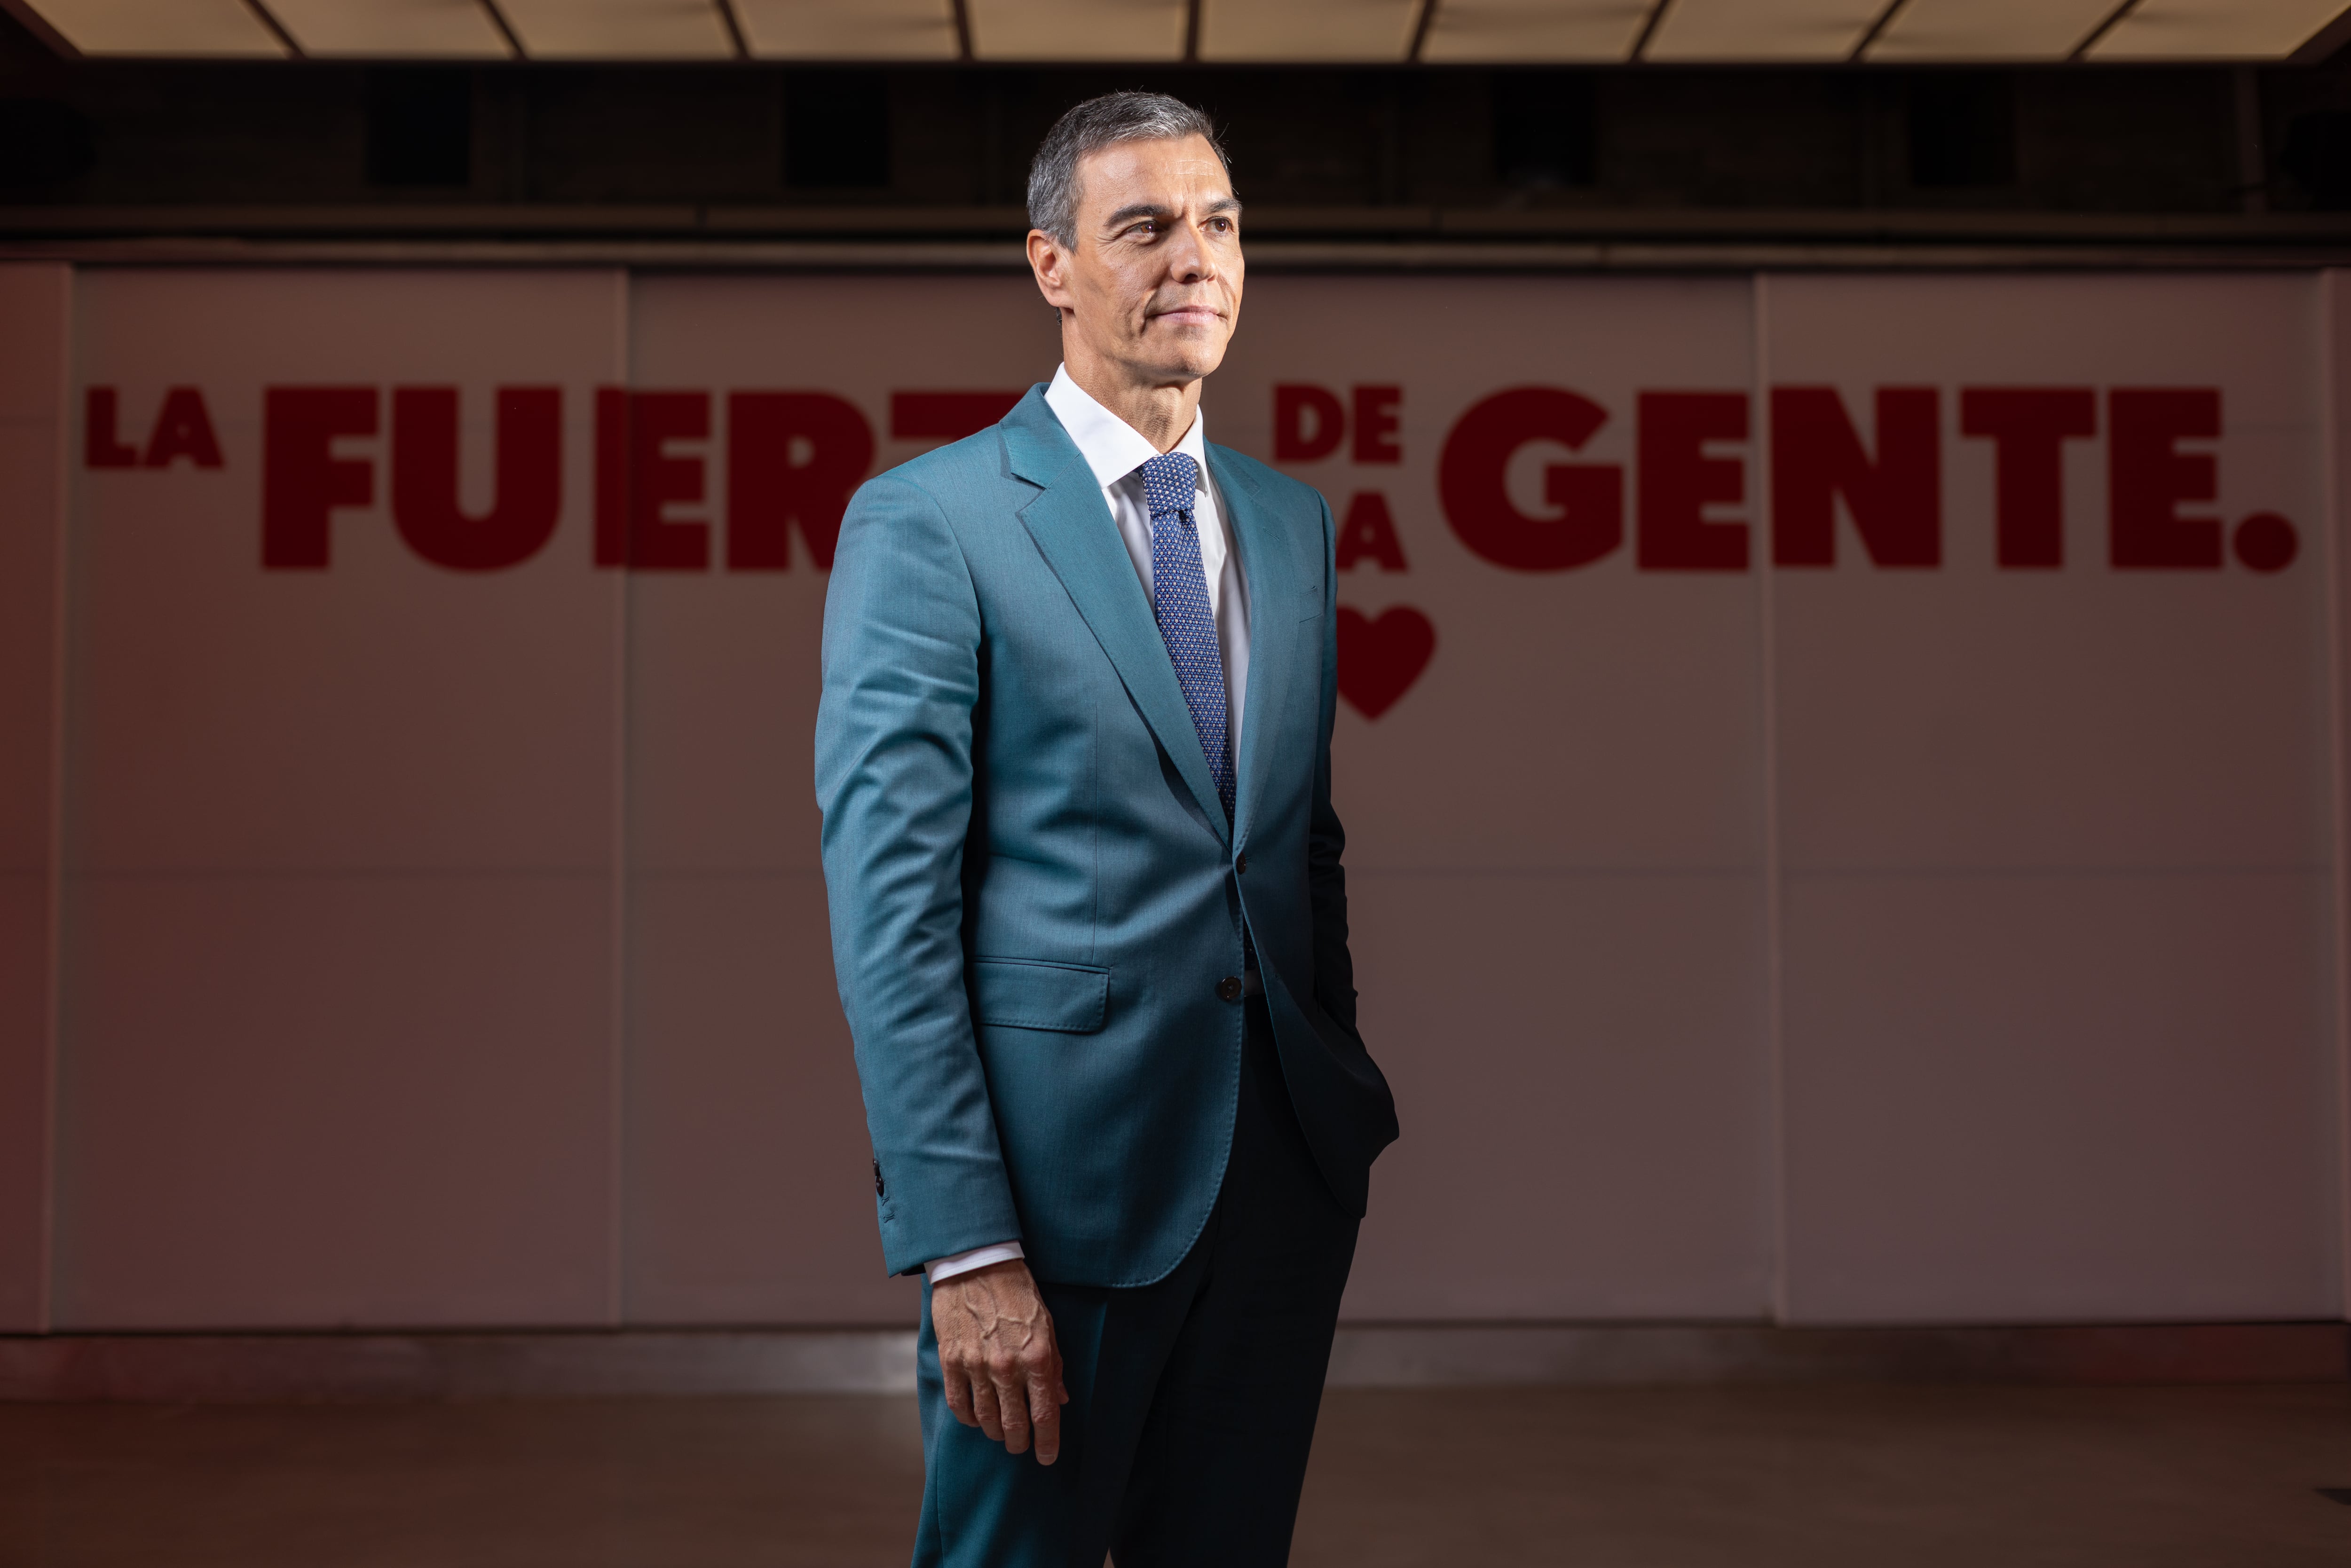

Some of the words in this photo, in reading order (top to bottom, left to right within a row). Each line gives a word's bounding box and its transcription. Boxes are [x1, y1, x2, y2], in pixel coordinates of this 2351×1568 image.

[87, 387, 223, 467] LA
[263, 387, 1026, 570] FUER
[1276, 386, 1400, 462] DE
[1439, 387, 2297, 571] GENTE.
[1336, 493, 1406, 570] A
